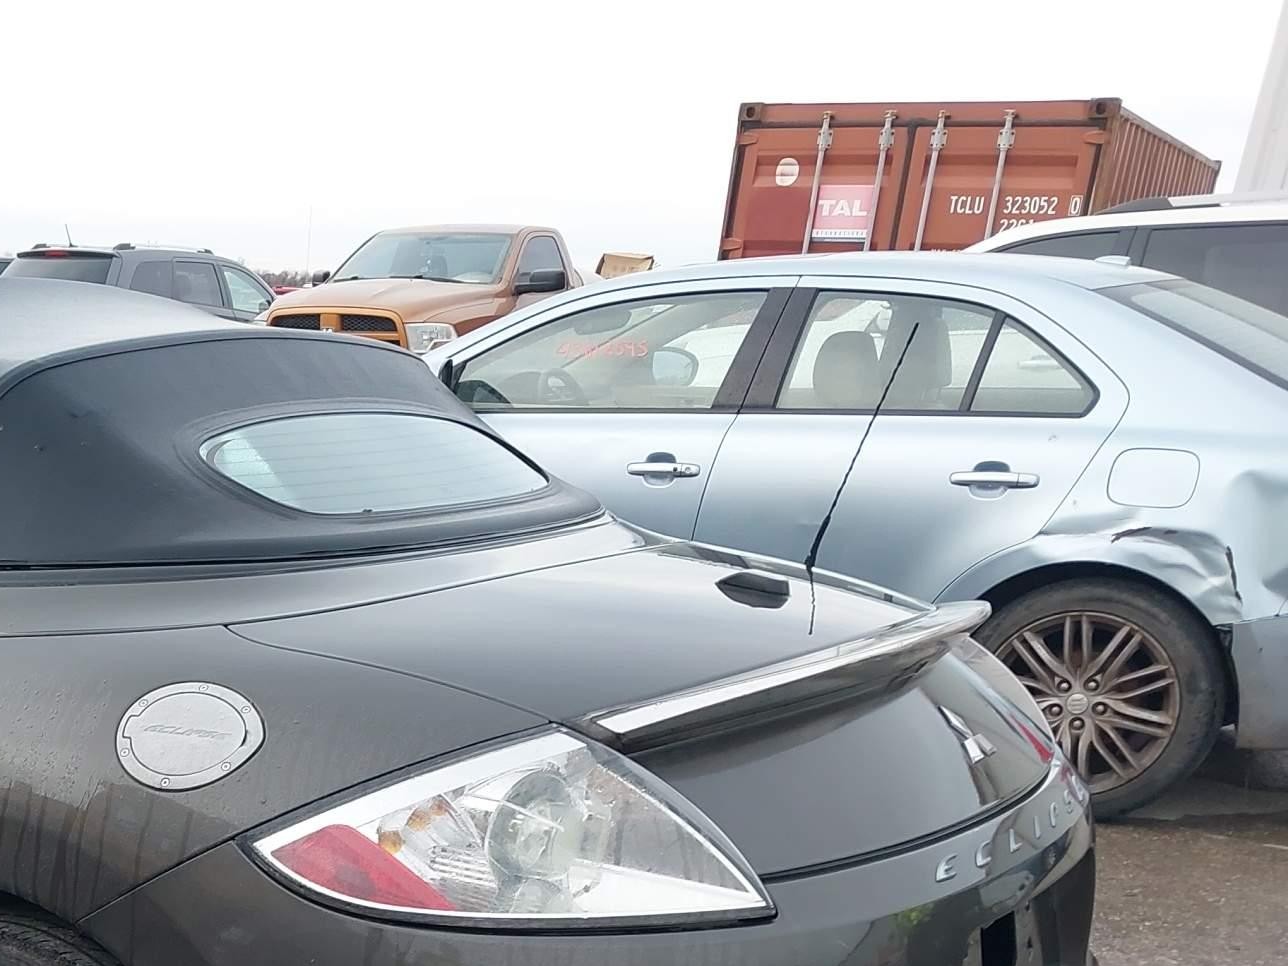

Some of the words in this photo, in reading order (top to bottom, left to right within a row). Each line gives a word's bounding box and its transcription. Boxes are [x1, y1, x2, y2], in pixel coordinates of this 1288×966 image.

[818, 199, 868, 217] TAL
[950, 196, 985, 215] TCLU
[1002, 196, 1059, 215] 323052
[1069, 196, 1082, 215] 0
